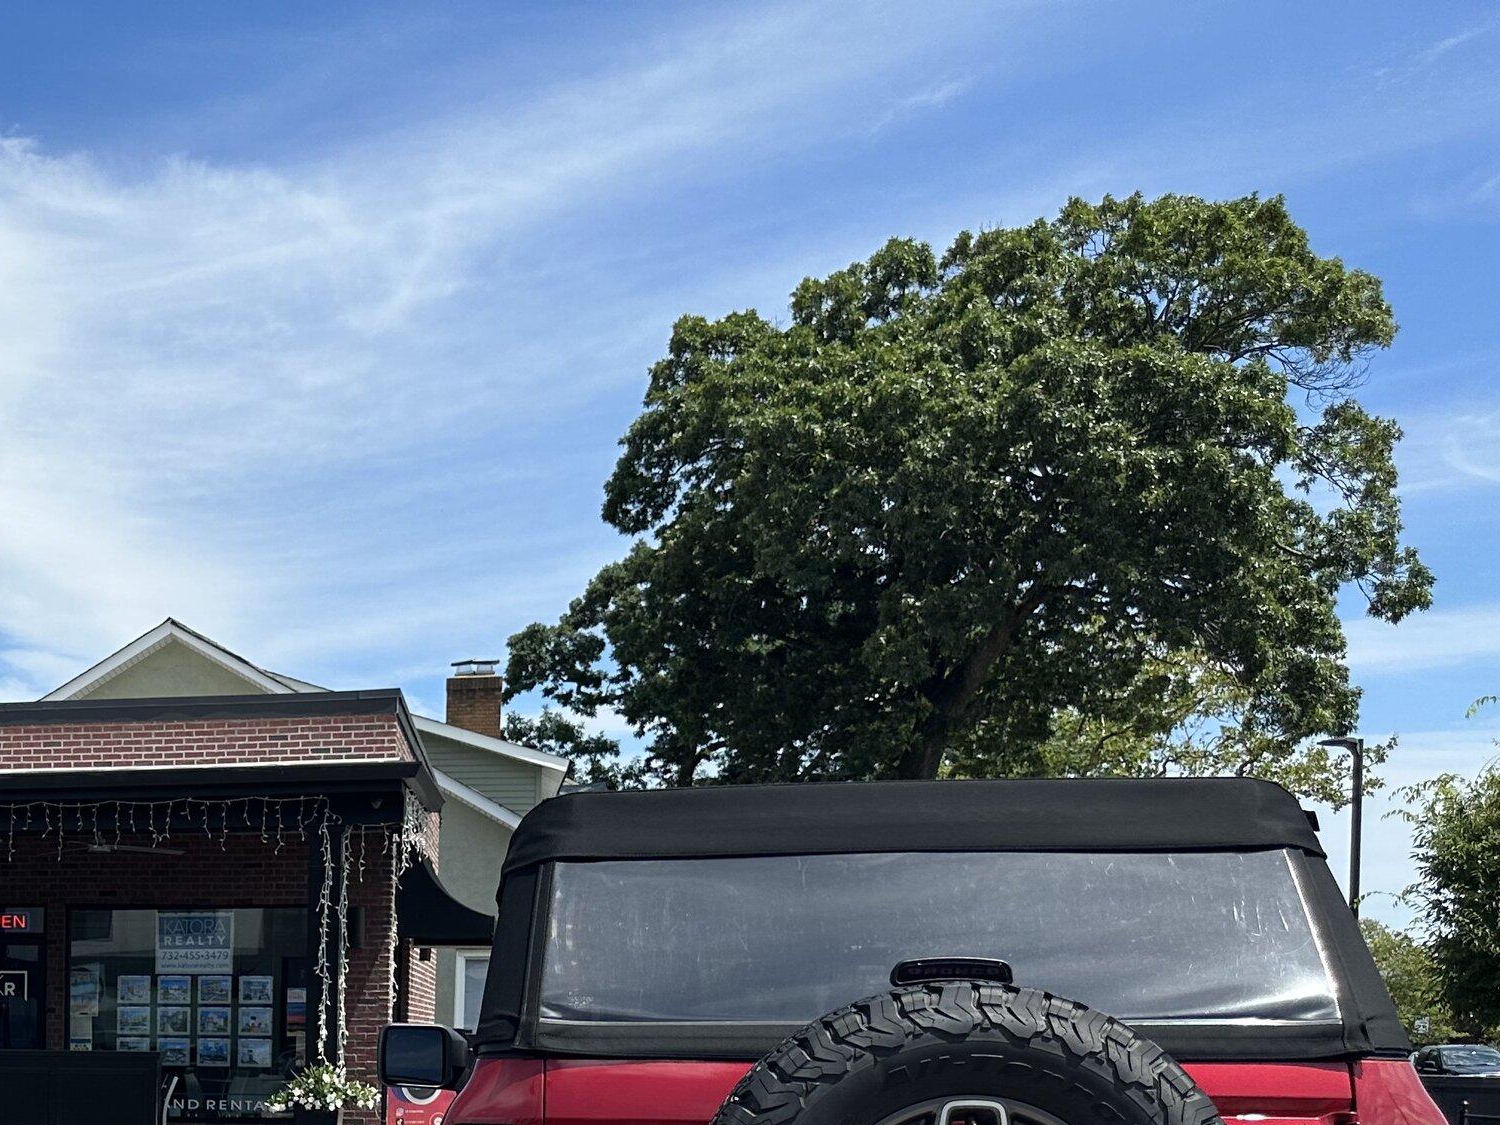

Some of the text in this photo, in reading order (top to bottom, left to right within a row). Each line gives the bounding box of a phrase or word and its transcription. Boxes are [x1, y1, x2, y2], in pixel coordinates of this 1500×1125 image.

[164, 919, 226, 935] KATORA
[164, 936, 226, 946] REALTY
[164, 1098, 266, 1111] ND RENTA
